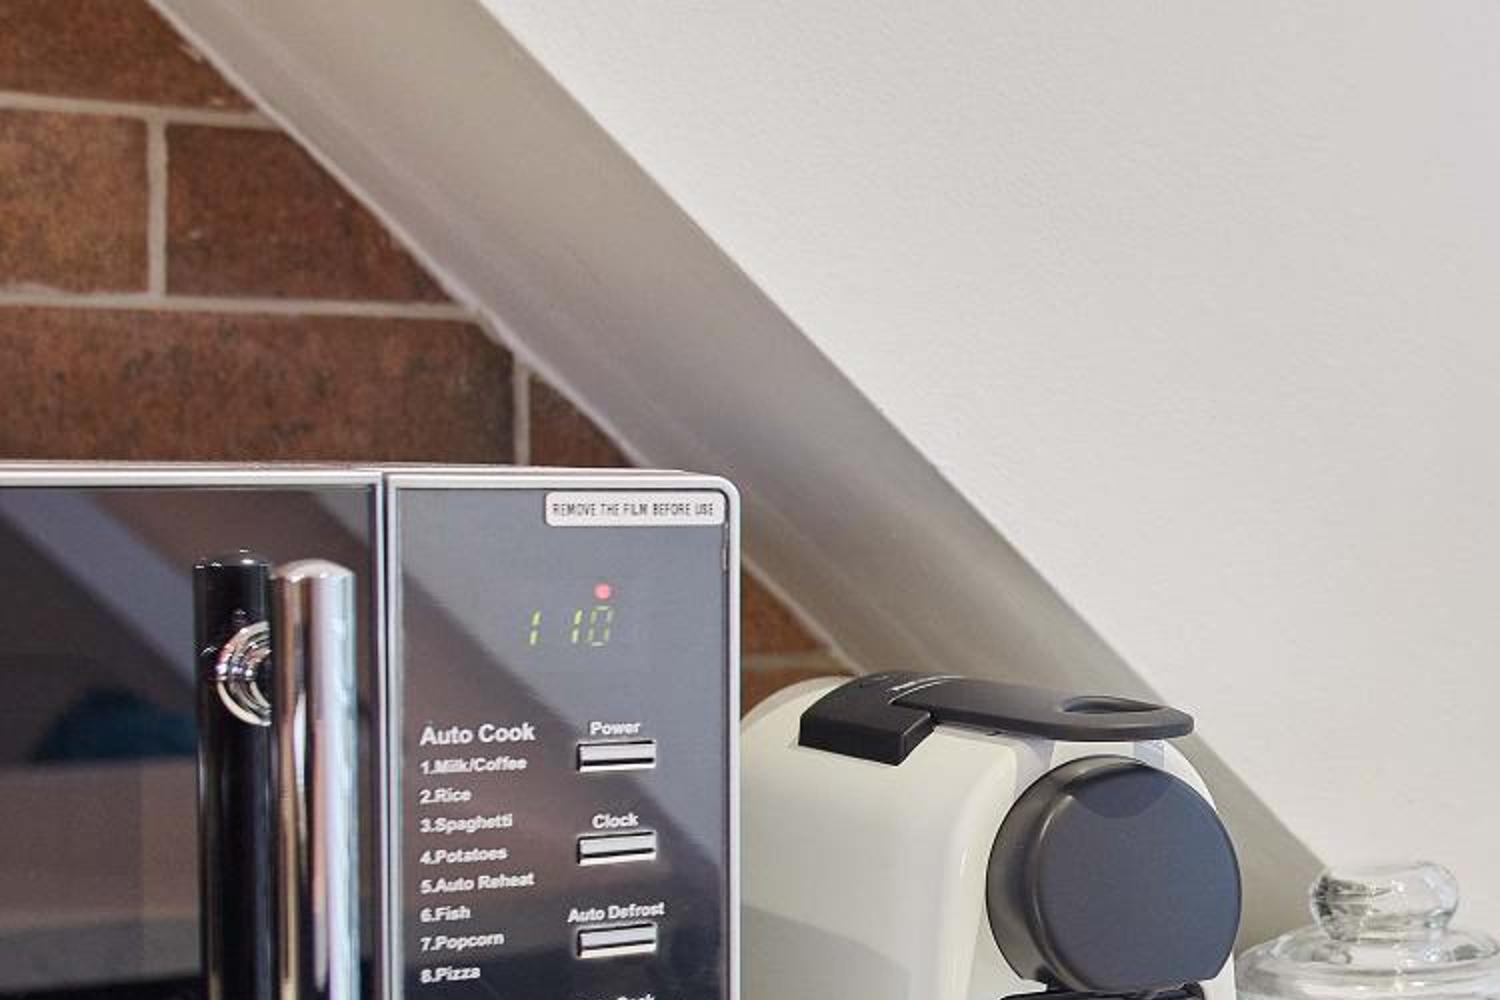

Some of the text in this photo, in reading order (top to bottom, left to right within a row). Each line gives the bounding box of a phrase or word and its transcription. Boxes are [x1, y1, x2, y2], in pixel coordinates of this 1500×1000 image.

[552, 501, 714, 516] REMOVE THE FILM BEFORE USE
[420, 723, 535, 745] Auto Cook
[589, 722, 641, 735] Power
[420, 757, 528, 774] 1.Milk/Coffee
[420, 789, 472, 804] 2.Rice
[420, 814, 513, 834] 3.Spaghetti
[592, 814, 639, 829] Clock
[420, 848, 508, 865] 4.Potatoes
[420, 873, 535, 894] 5.Auto Reheat
[420, 905, 471, 922] 6.Fish
[568, 903, 665, 923] Auto Defrost
[420, 933, 504, 951] 7.Popcorn
[420, 967, 481, 983] 8.Pizza
